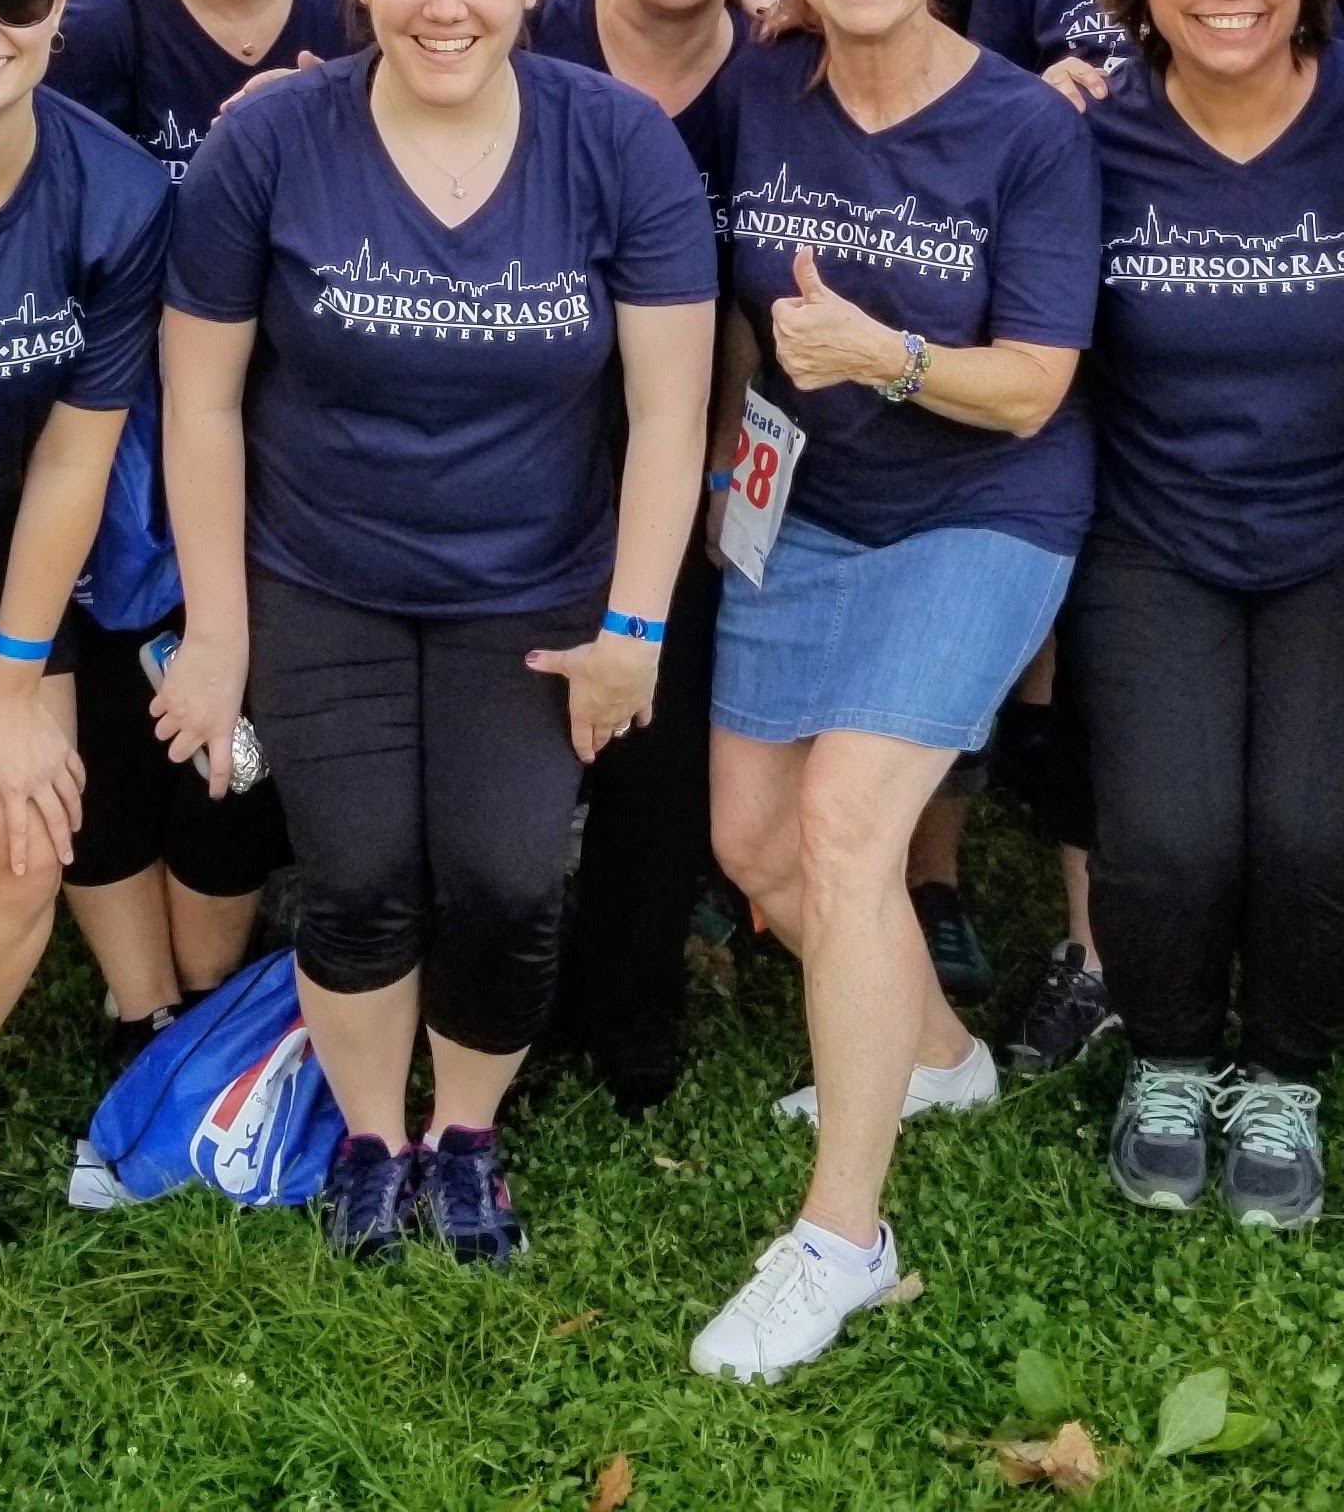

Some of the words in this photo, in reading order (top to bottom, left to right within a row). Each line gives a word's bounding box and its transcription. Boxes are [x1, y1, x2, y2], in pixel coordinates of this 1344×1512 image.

[736, 209, 870, 246] ANDERSON
[878, 228, 974, 266] RASOR
[757, 237, 894, 268] PARTNERS
[918, 264, 971, 282] LLP
[1110, 254, 1274, 278] ANDERSON
[321, 284, 480, 325] ANDERSON
[494, 294, 590, 325] RASOR
[1140, 280, 1314, 294] PARTNERS
[11, 325, 84, 360] RASO
[344, 317, 516, 342] PARTNERS
[730, 426, 779, 510] 28
